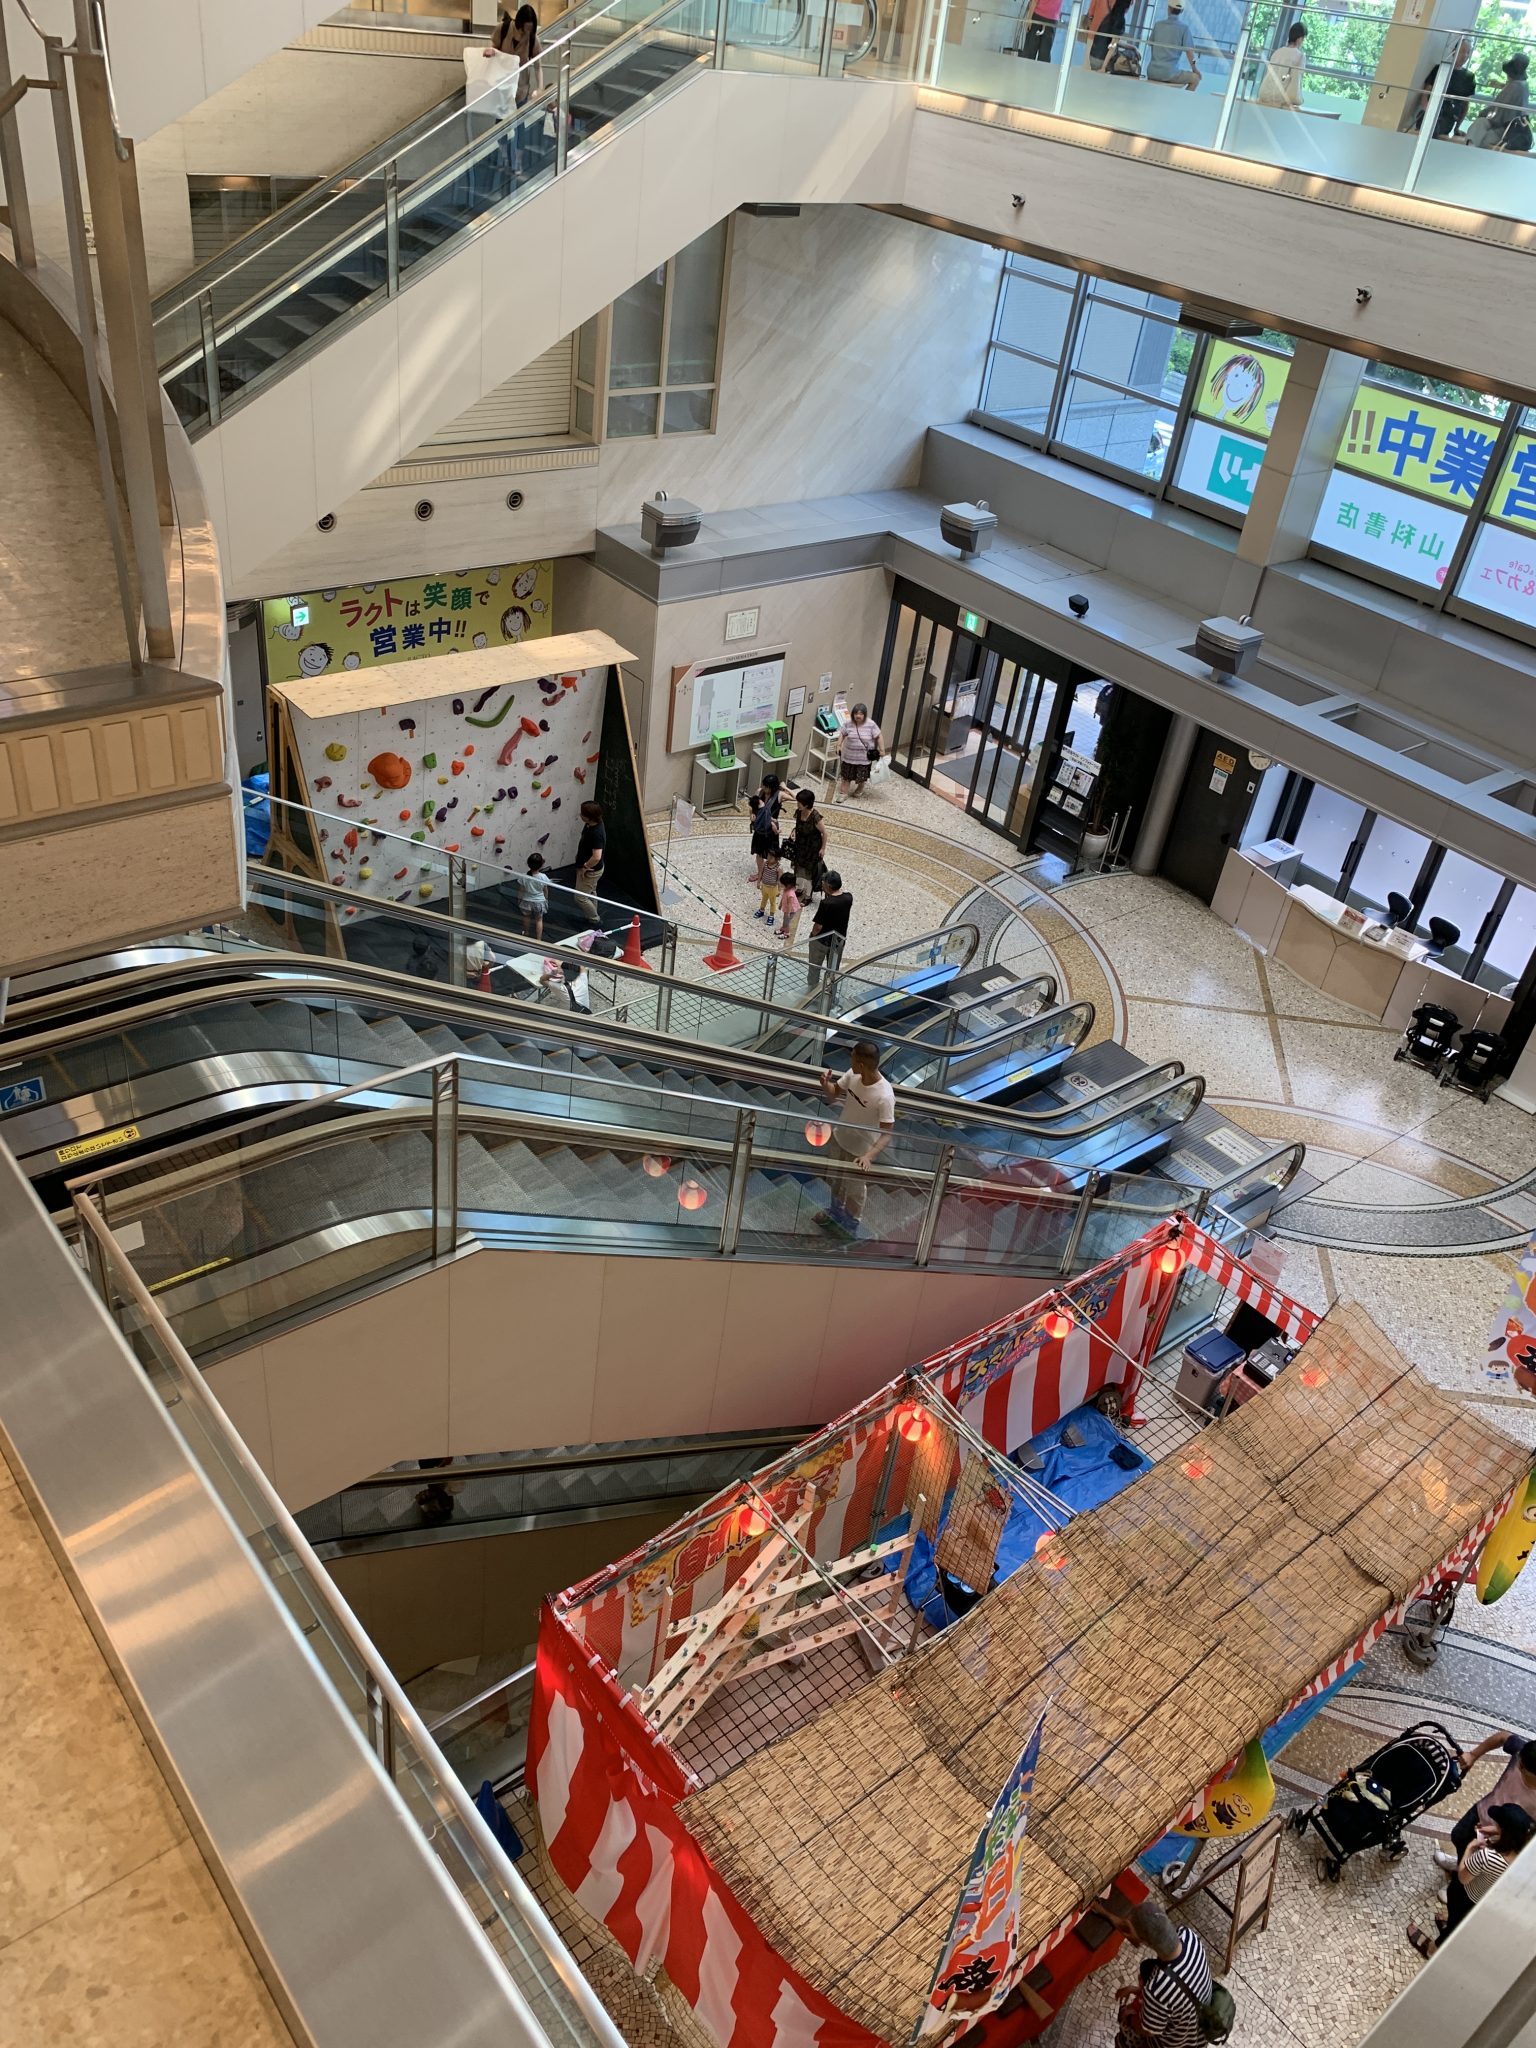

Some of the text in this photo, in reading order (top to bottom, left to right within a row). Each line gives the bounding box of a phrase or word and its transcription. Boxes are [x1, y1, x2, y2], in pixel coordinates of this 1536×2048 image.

[340, 581, 490, 628] ラクトは笑顔で
[370, 616, 467, 658] 営業中!!
[1217, 753, 1234, 766] AED
